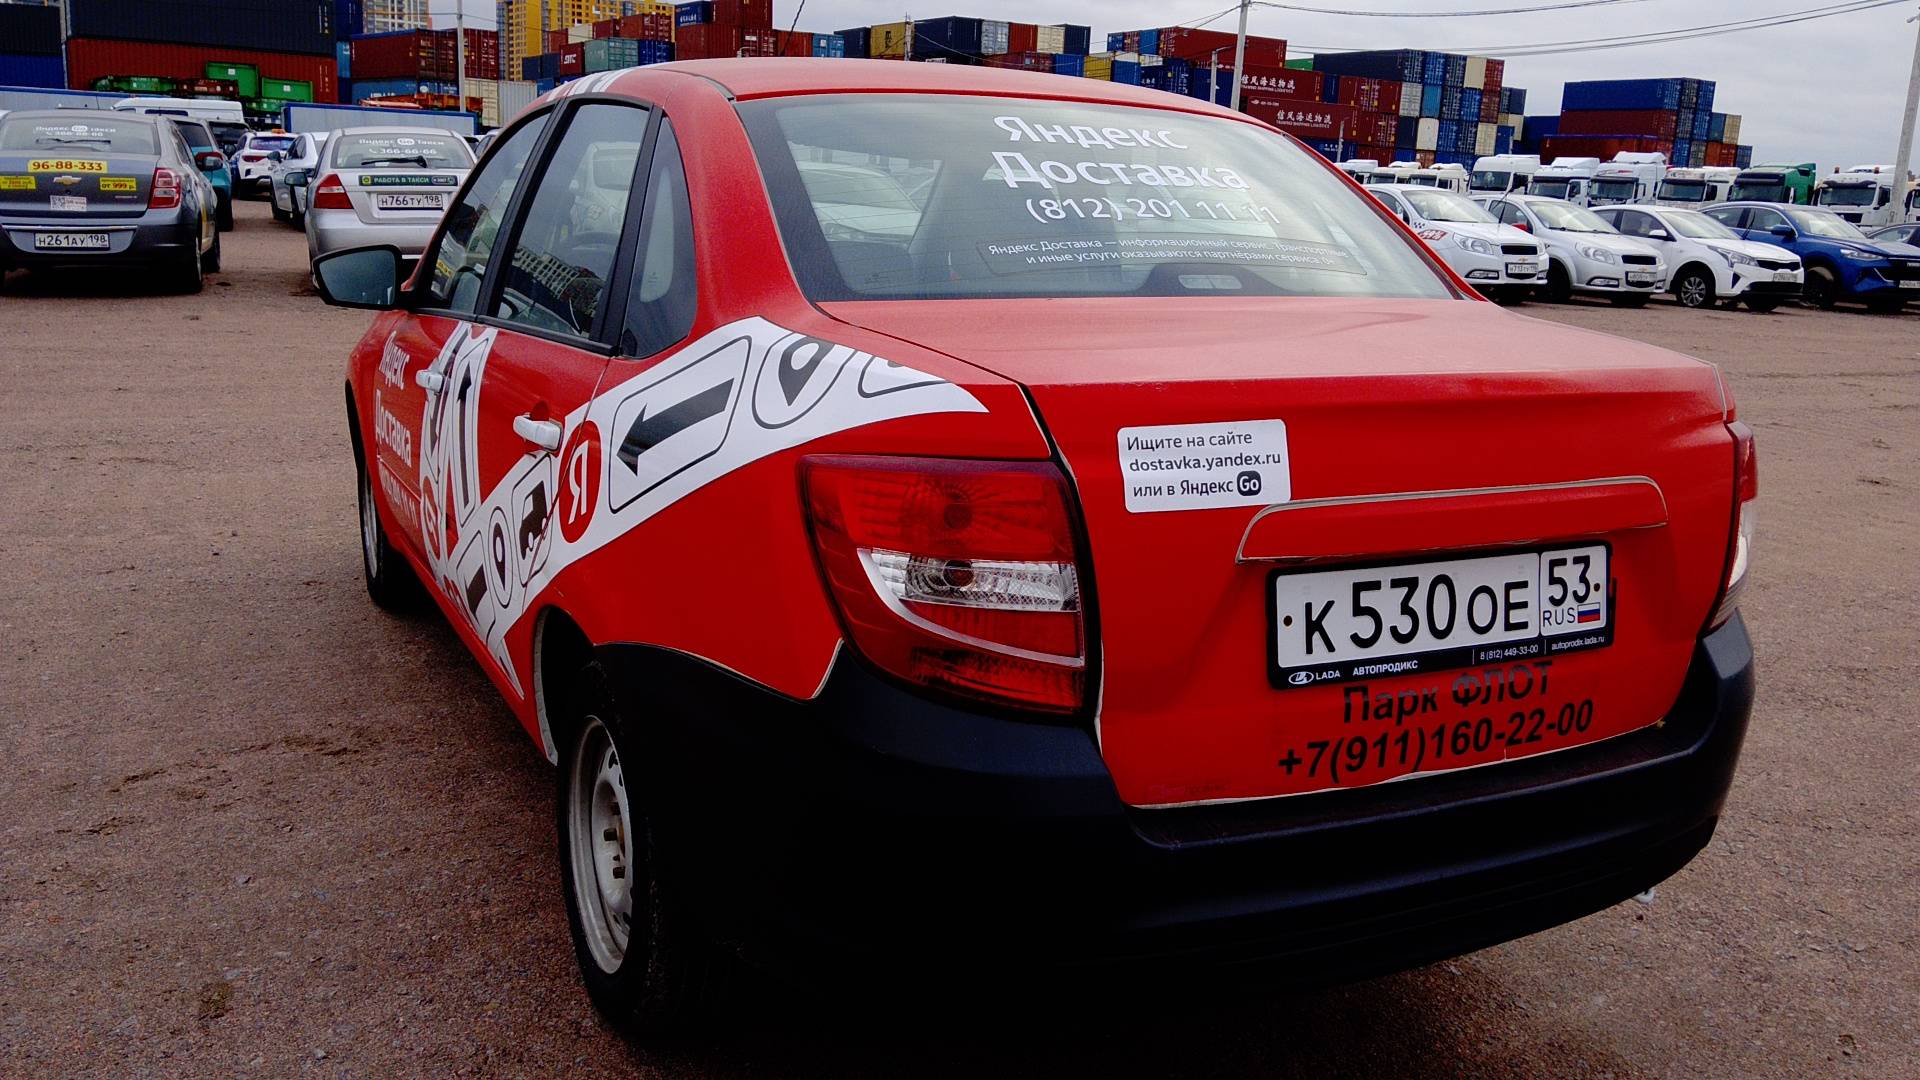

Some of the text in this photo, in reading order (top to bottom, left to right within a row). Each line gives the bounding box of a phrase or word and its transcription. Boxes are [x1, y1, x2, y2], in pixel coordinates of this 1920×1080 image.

[1241, 74, 1295, 89] 信风海运物流
[1276, 109, 1332, 125] 信风海运物流
[994, 116, 1187, 149] Яндекс
[32, 160, 103, 171] 96-88-333
[992, 151, 1250, 190] Доставка
[1026, 196, 1281, 224] (812) 201 11 11
[88, 234, 106, 243] 198
[988, 243, 1039, 255] Яндекс
[1040, 239, 1103, 252] Доставка
[1118, 237, 1230, 248] информационный
[1026, 256, 1036, 265] и
[1038, 253, 1074, 263] иные
[1075, 251, 1120, 262] услуги
[1121, 250, 1203, 259] оказываются
[1203, 251, 1276, 262] партнёрами
[375, 388, 412, 468] Доставка
[1126, 432, 1253, 452] Ищите на сайте
[1129, 452, 1281, 472] dostavka.yandex.ru
[568, 440, 588, 526] Я
[1133, 475, 1260, 497] или в Яндекс Go
[1548, 555, 1591, 607] 53
[1542, 607, 1576, 628] RUS
[1315, 636, 1605, 681] LADA АВТОПРОДИКС 8 (812) 449-33-00 autoprodix.lada.ru
[1343, 660, 1552, 726] Парк ФЛОТ
[1278, 699, 1595, 784] +7(911)160-22-00
